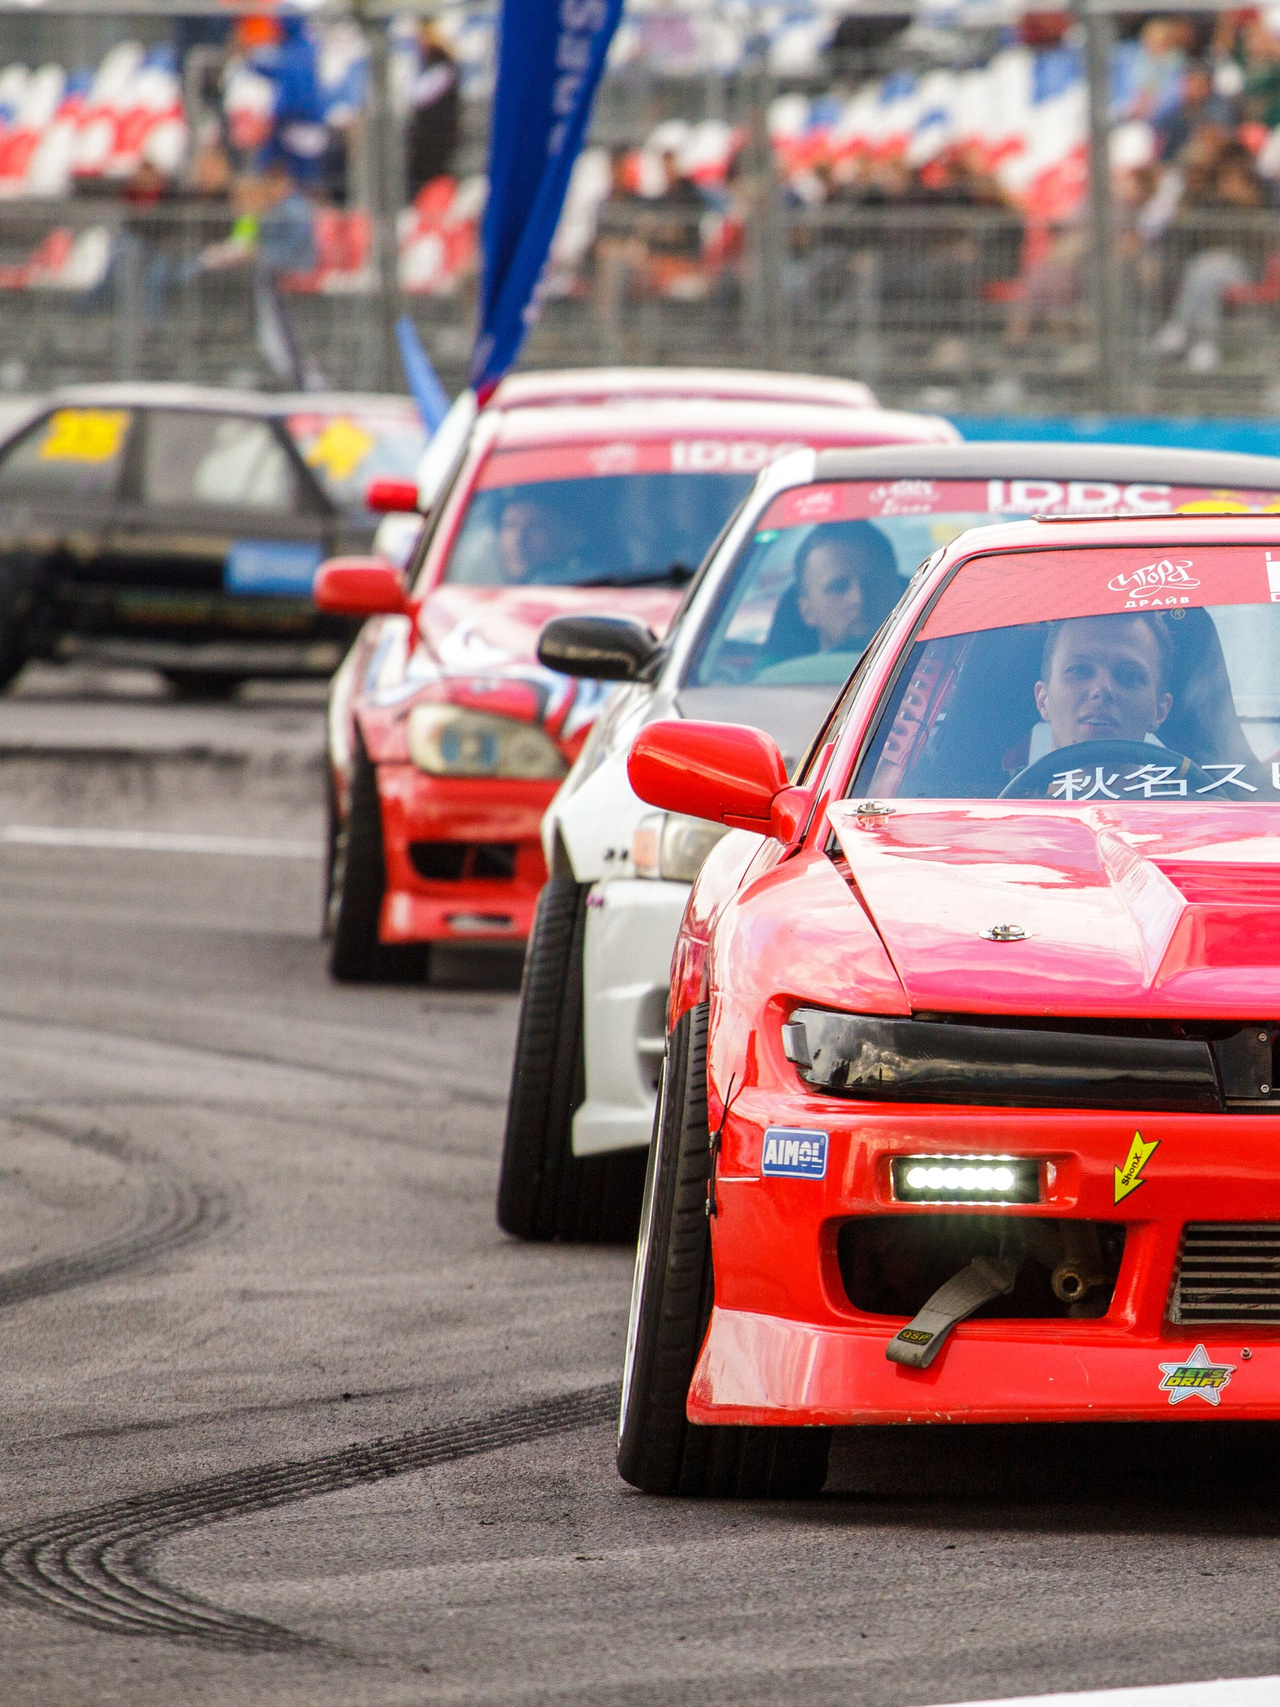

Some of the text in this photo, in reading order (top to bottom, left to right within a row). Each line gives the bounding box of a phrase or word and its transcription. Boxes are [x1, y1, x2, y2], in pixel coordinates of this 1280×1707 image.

[988, 480, 1172, 513] IDDC
[1123, 596, 1190, 608] ДРАЙВ
[764, 1139, 823, 1168] AIMOL
[1174, 1368, 1226, 1378] LET'S
[1165, 1377, 1225, 1387] DRIFT
